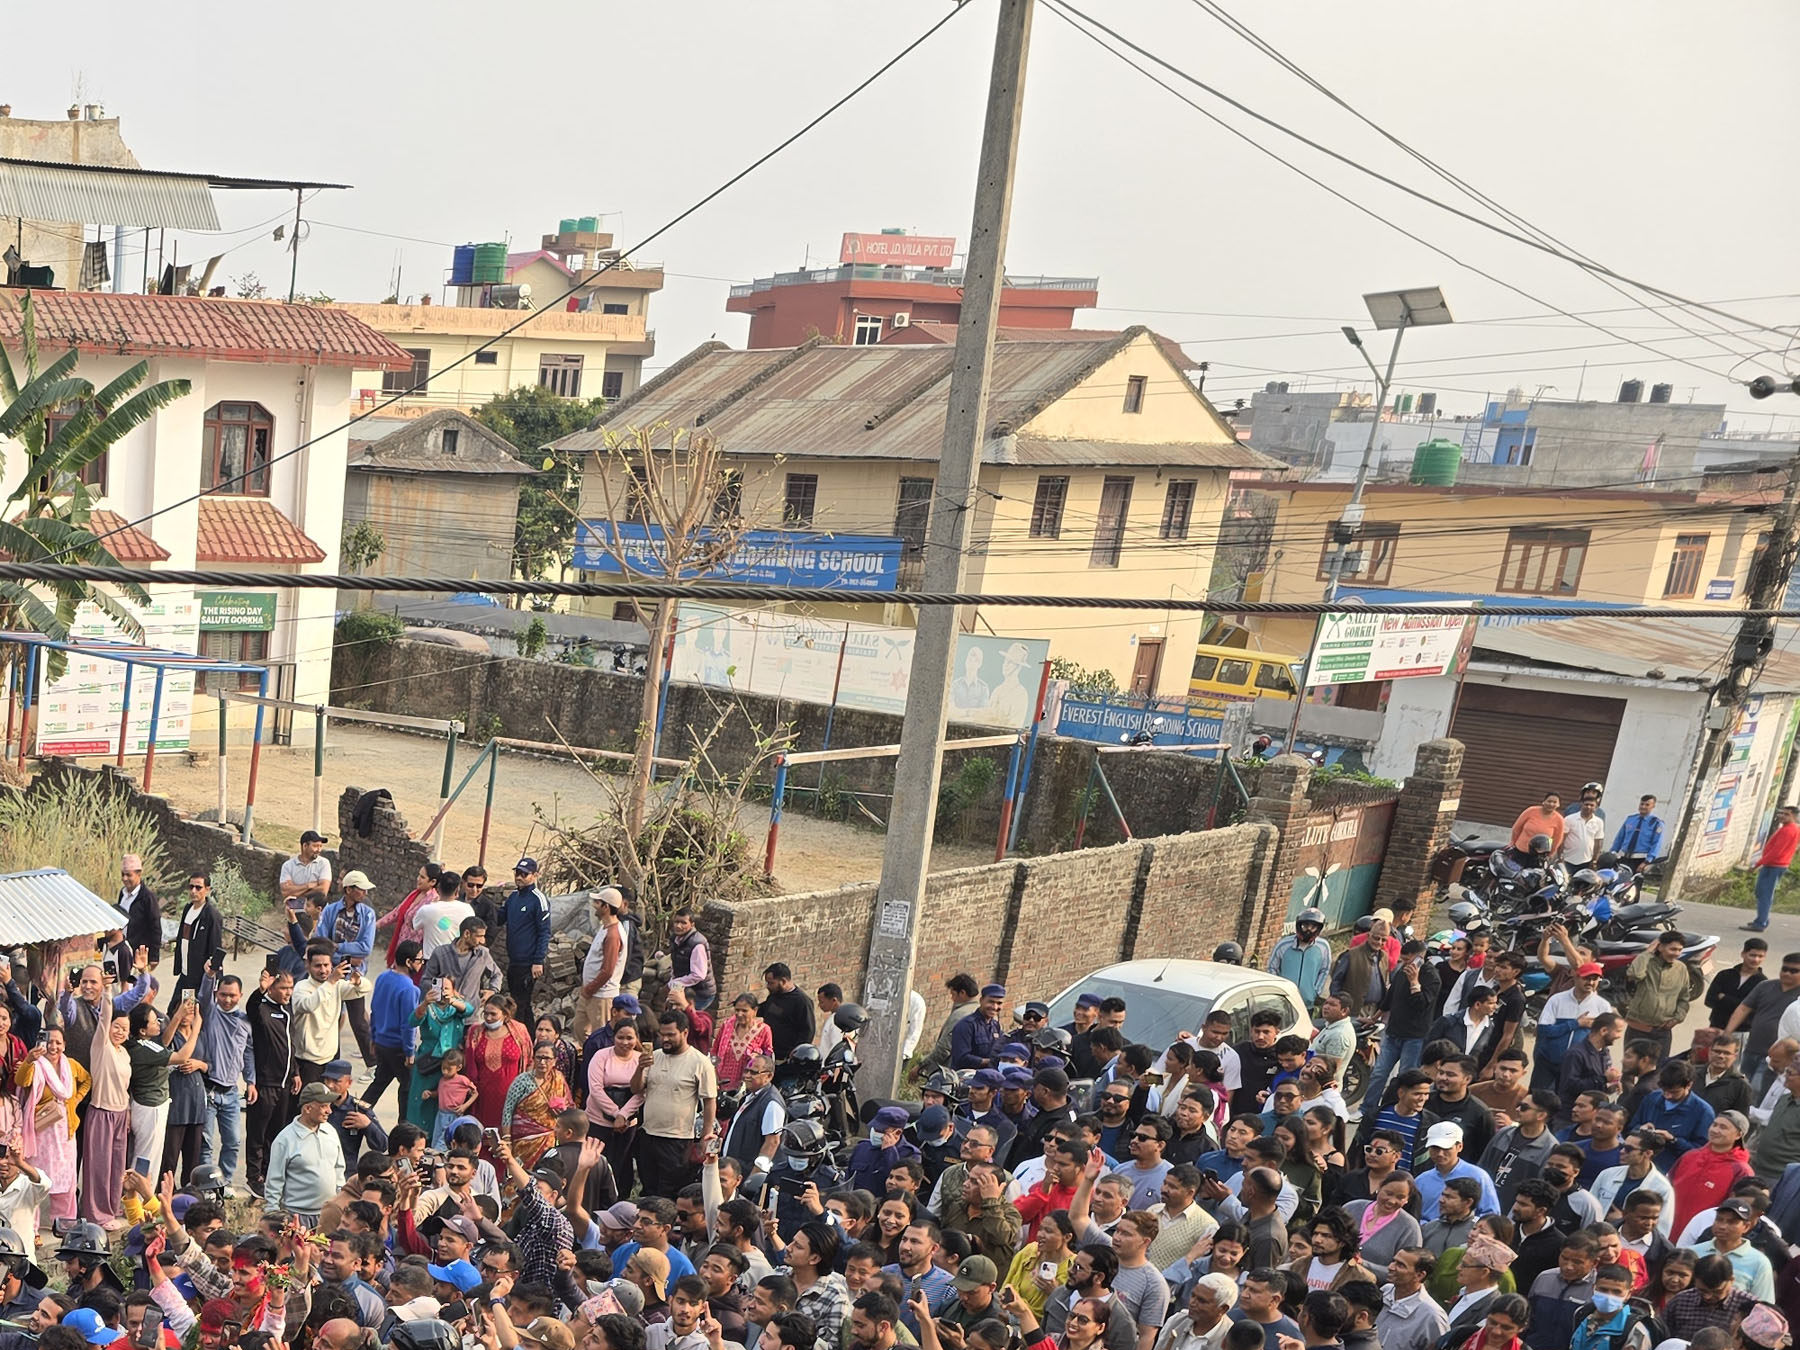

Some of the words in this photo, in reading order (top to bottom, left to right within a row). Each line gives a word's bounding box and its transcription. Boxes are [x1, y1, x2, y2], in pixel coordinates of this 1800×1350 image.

[866, 242, 888, 255] HOTEL
[902, 243, 921, 256] VILLA
[818, 550, 885, 574] SCHOOL
[203, 607, 218, 615] THE
[219, 607, 246, 615] RISING
[246, 607, 263, 615] DAY
[201, 616, 230, 624] SALUTE
[231, 616, 264, 625] GORKHA
[1380, 614, 1400, 631] New
[1401, 613, 1443, 630] Admission
[1062, 703, 1103, 725] EVEREST
[1103, 708, 1142, 730] ENGLISH
[1185, 718, 1221, 740] SCHOOL
